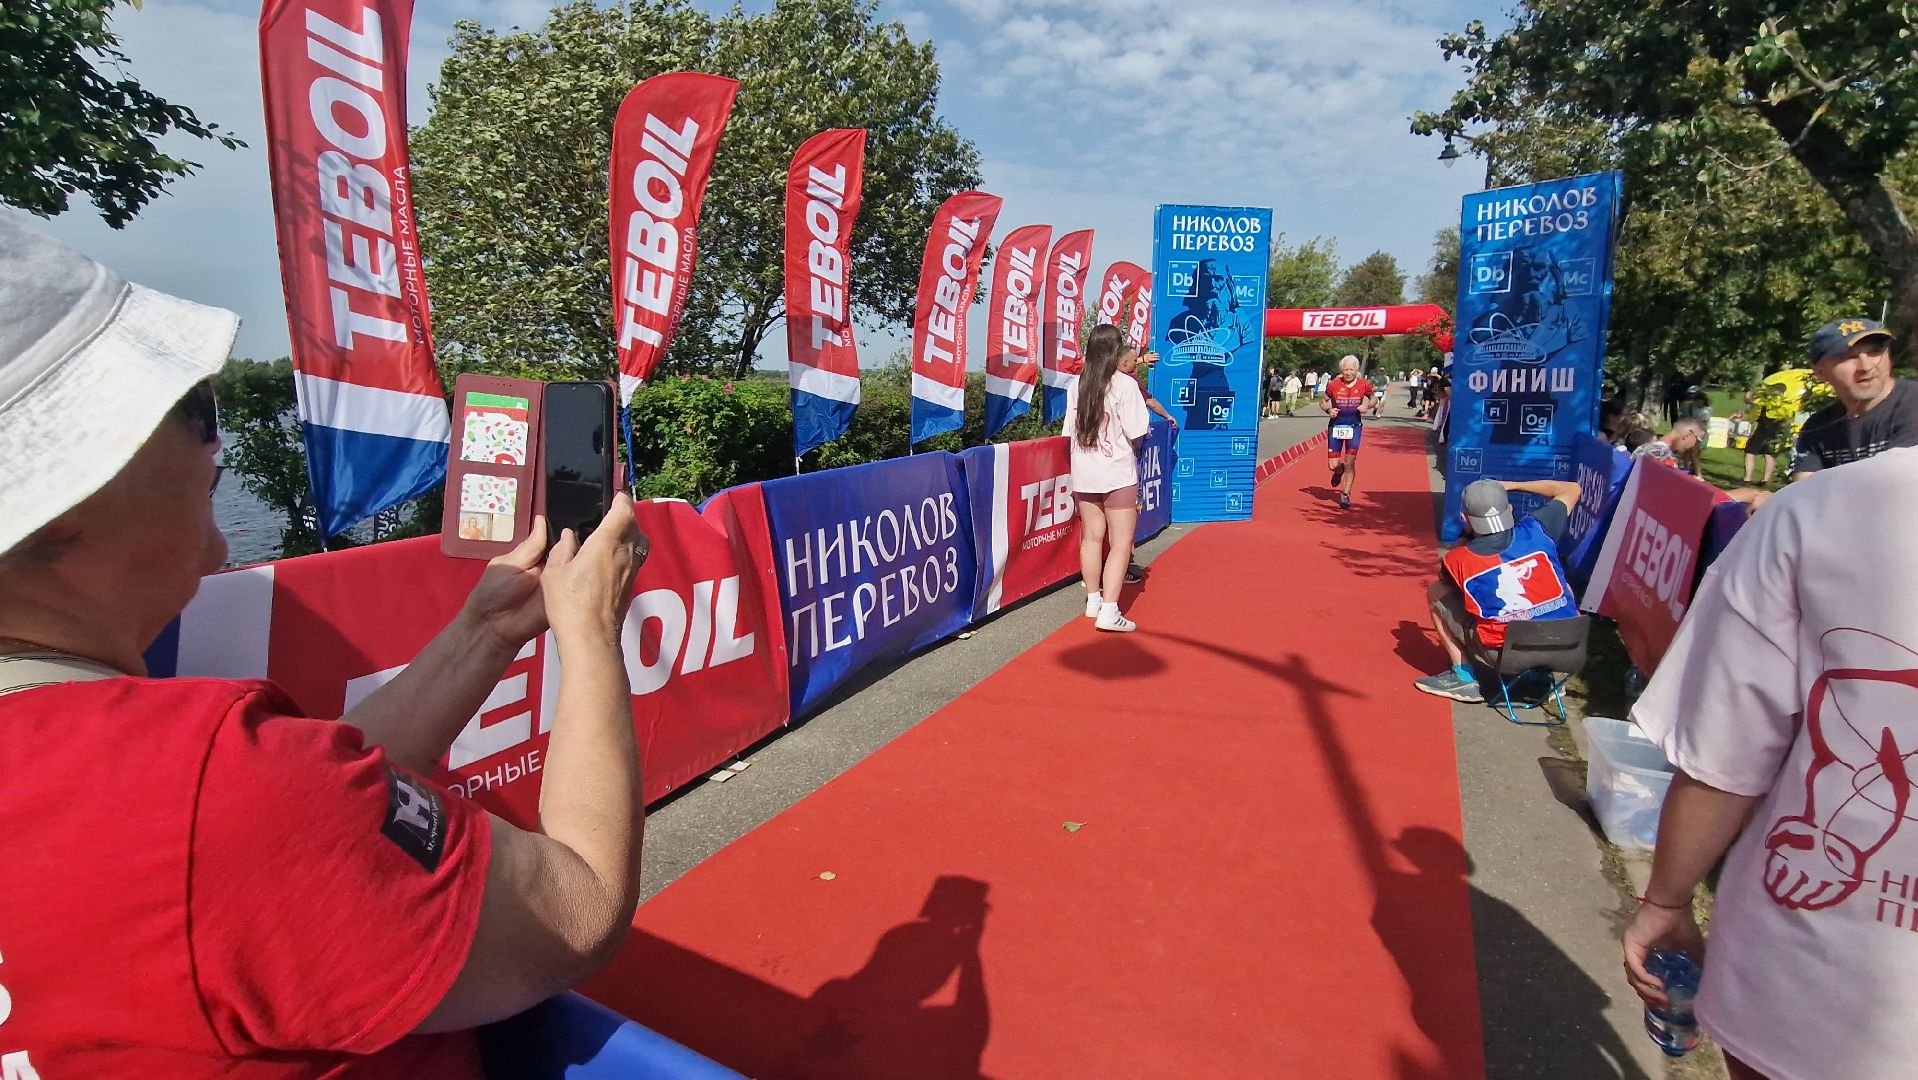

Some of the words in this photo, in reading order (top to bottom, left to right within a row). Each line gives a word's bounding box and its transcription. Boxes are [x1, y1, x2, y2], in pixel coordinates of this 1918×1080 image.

[305, 6, 408, 351] TEBOIL
[394, 165, 407, 236] МАСЛА
[1477, 186, 1598, 222] НИКОЛОВ
[619, 112, 700, 351] TEBOIL
[1172, 214, 1262, 234] НИКОЛОВ
[1477, 210, 1590, 242] ПЕРЕВОЗ
[679, 226, 695, 278] МАСЛА
[808, 162, 846, 350] TEBOIL
[1172, 233, 1255, 252] ПЕРЕВОЗ
[923, 214, 982, 364] TEBOIL
[1172, 272, 1194, 287] Db
[1477, 265, 1505, 282] Db
[1563, 270, 1588, 286] Mc
[402, 239, 424, 346] МОТОРНЫЕ
[1002, 246, 1037, 368] TEBOIL
[1056, 250, 1082, 362] TEBOIL
[1235, 285, 1255, 298] Mc
[1308, 312, 1380, 328] TEBOIL
[1468, 367, 1575, 393] ФИНИШ
[1212, 404, 1230, 418] Og
[1525, 413, 1548, 429] Og
[1336, 429, 1350, 437] 157
[1460, 455, 1478, 467] No
[1020, 474, 1077, 537] TEB
[784, 491, 959, 598] НИКОЛОВ
[1021, 530, 1057, 552] МОТОРНЫЕ
[1625, 508, 1693, 623] TEBOIL
[790, 549, 960, 668] ПЕРЕВОЗ
